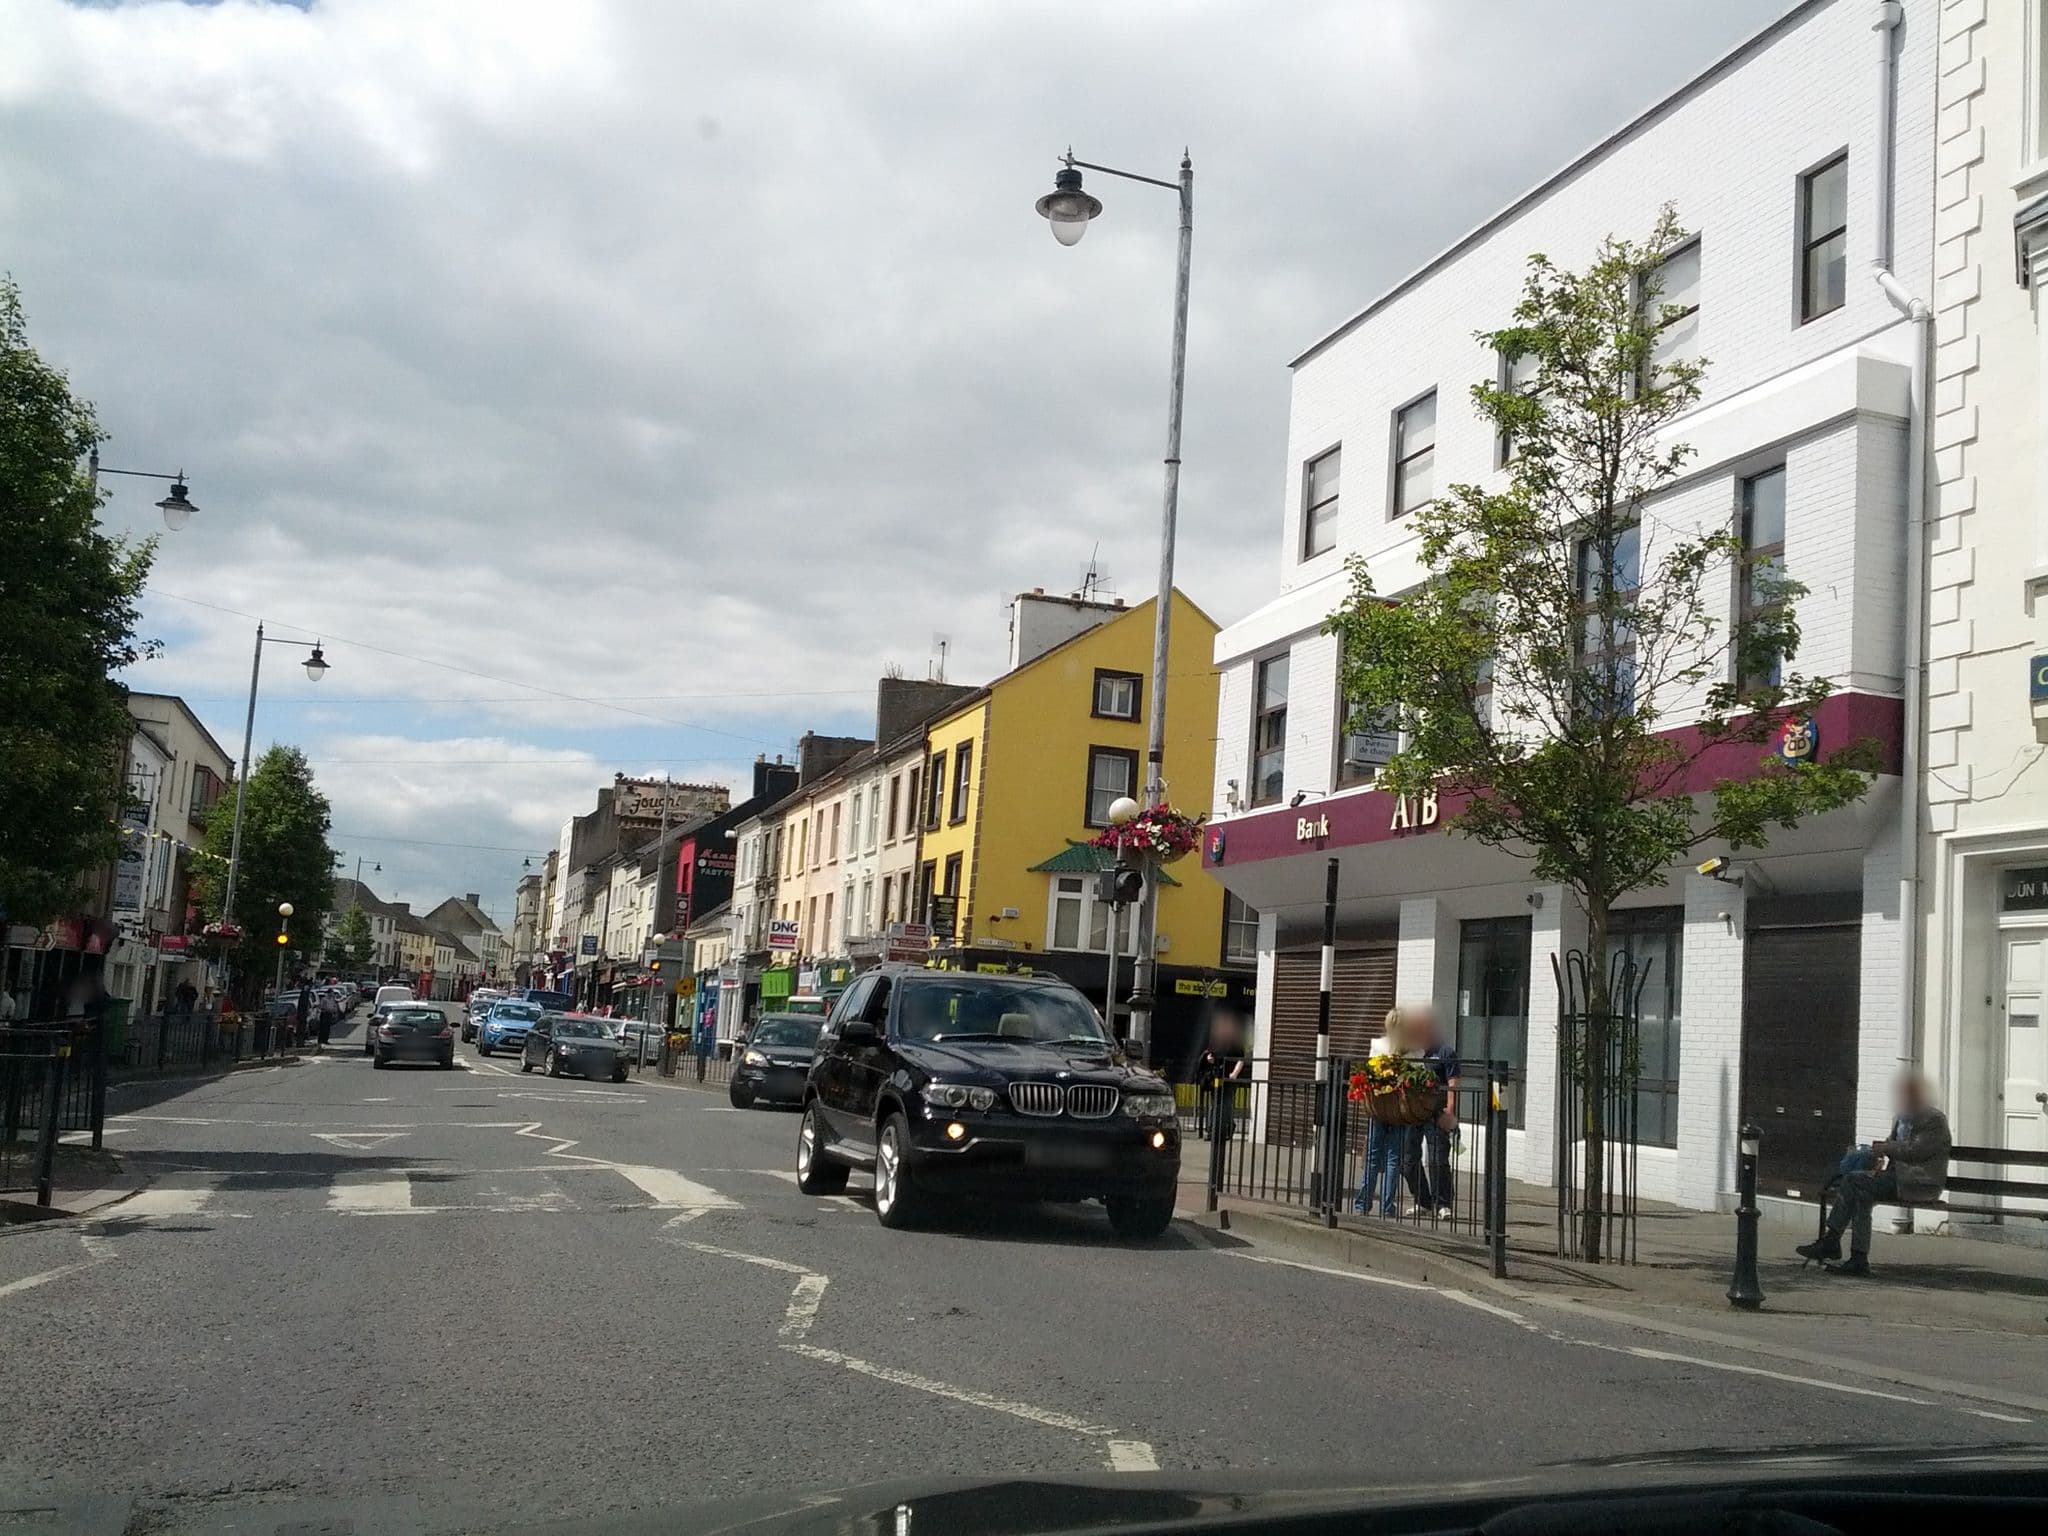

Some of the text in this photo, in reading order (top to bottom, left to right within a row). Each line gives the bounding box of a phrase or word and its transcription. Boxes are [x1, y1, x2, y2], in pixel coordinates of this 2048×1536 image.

[1390, 792, 1438, 830] AIB
[1296, 813, 1329, 840] Bank
[771, 921, 799, 933] DNG
